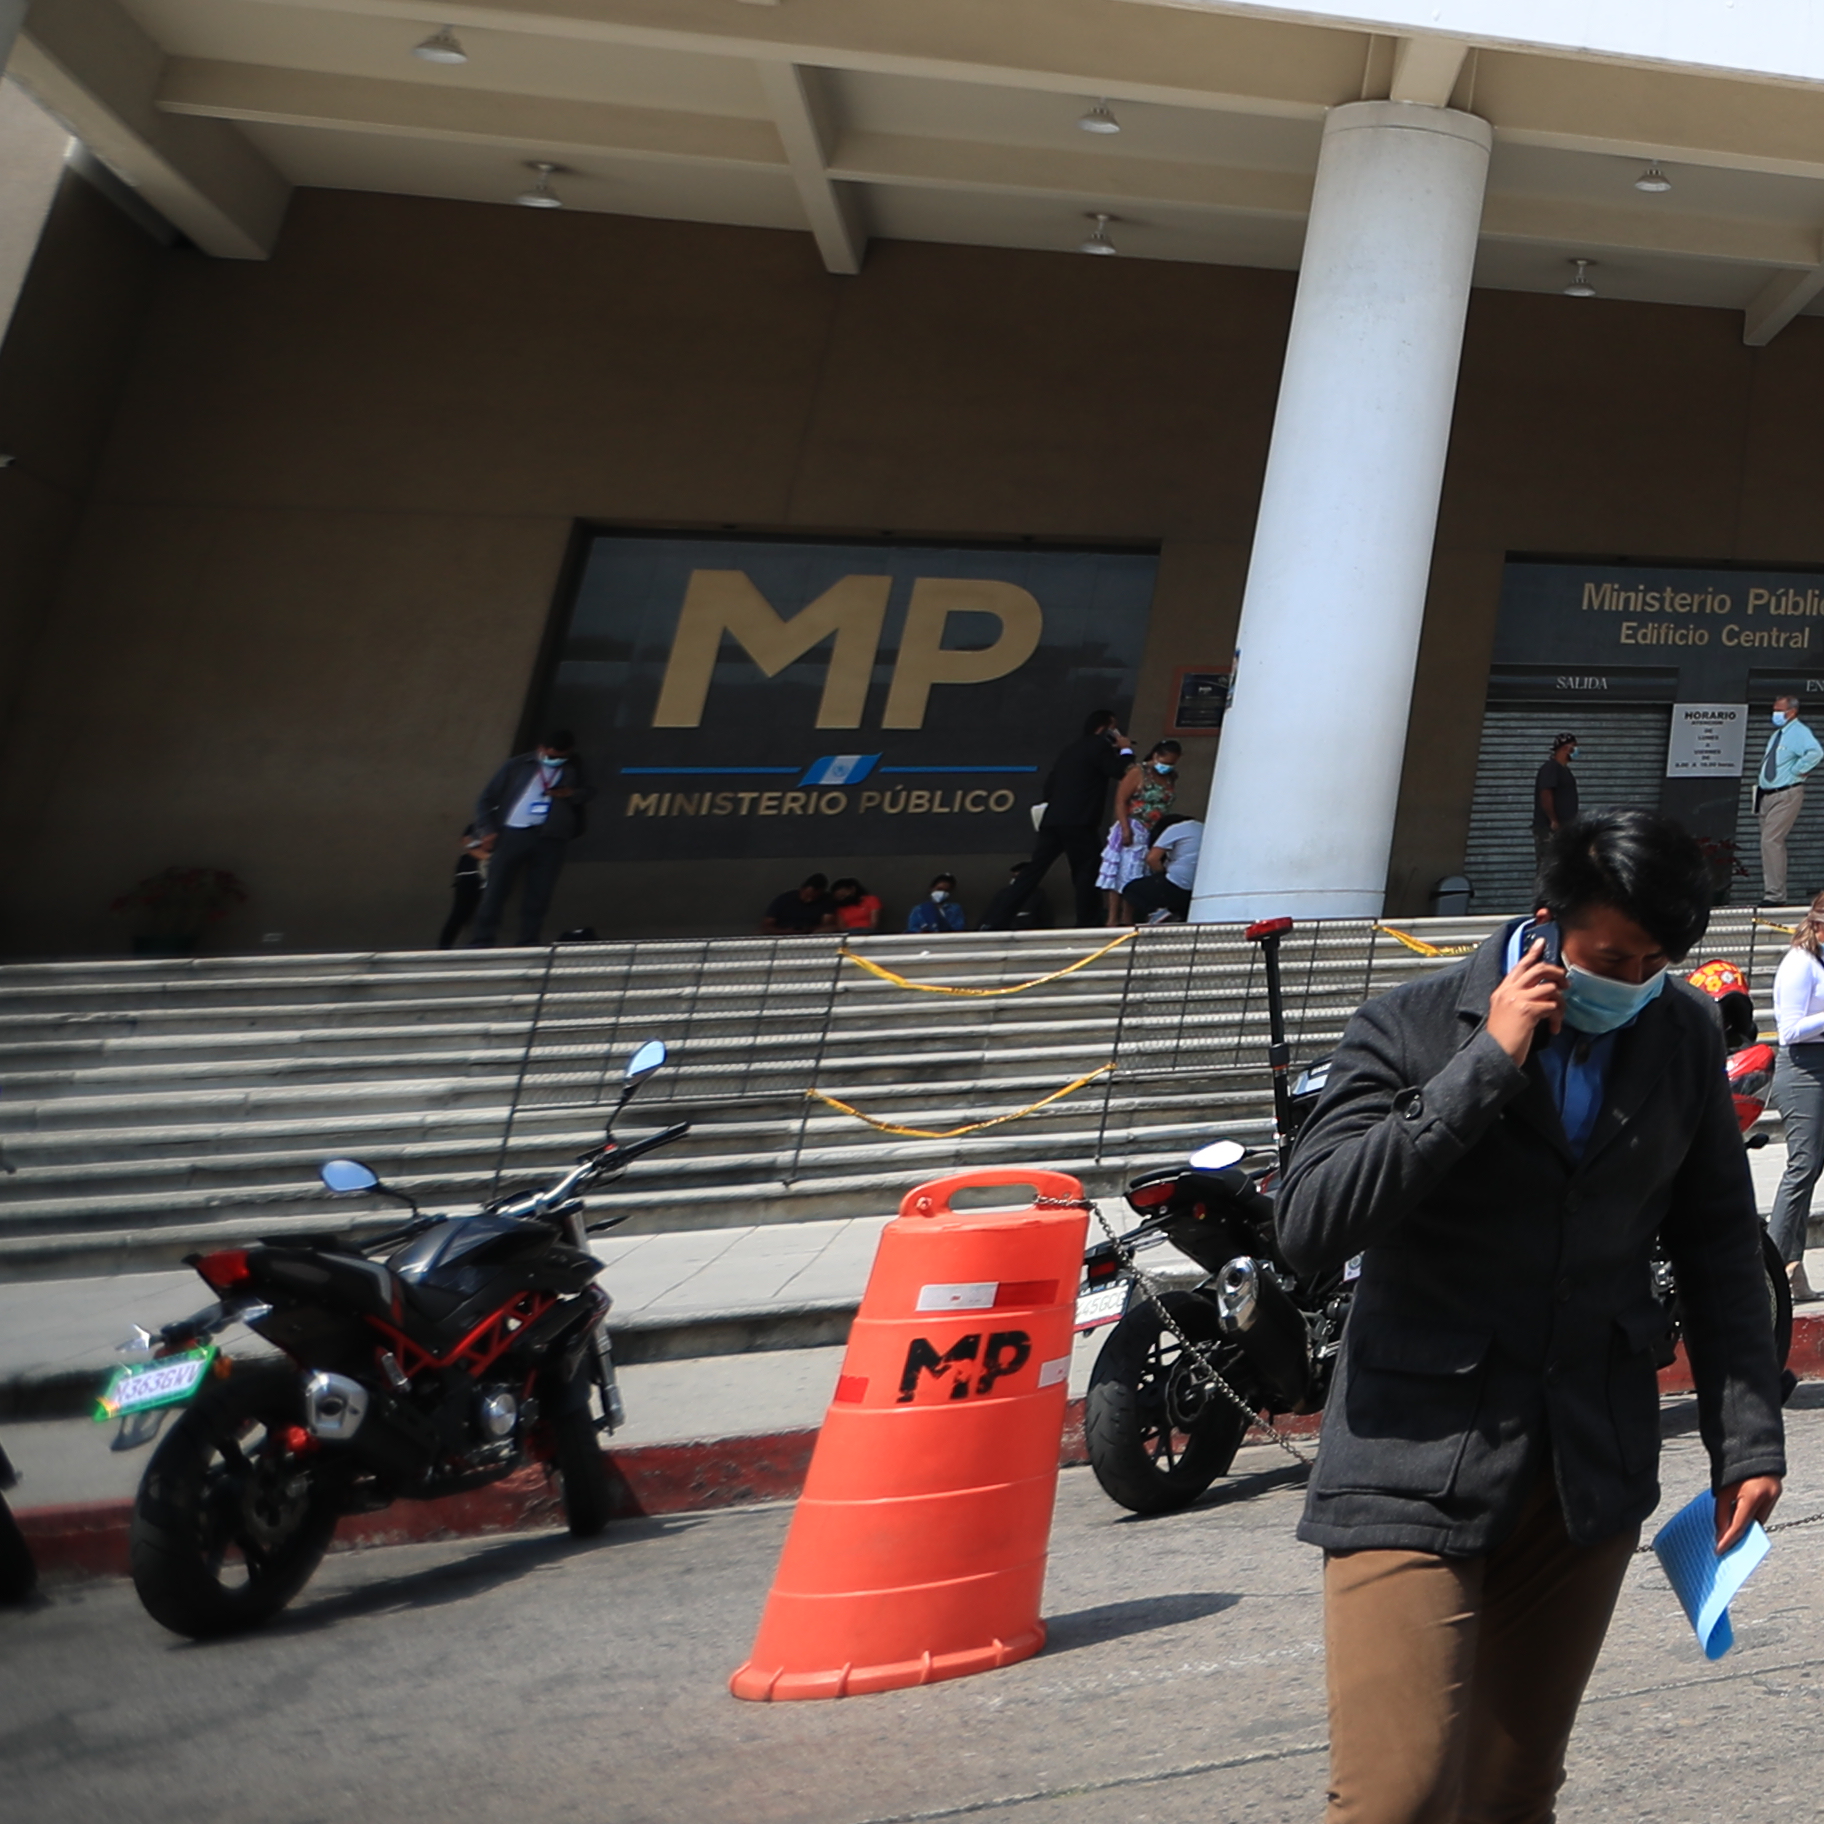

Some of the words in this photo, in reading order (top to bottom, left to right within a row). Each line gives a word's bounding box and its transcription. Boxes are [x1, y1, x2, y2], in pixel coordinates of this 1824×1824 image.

[1581, 582, 1732, 615] Ministerio
[652, 569, 1043, 730] MP
[1619, 621, 1710, 647] Edificio
[1721, 624, 1810, 649] Central
[1555, 675, 1609, 691] SALIDA
[1683, 711, 1737, 721] HORARIO
[626, 789, 849, 817] MINISTERIO
[858, 785, 1016, 814] PÚBLICO
[896, 1330, 1032, 1404] MP
